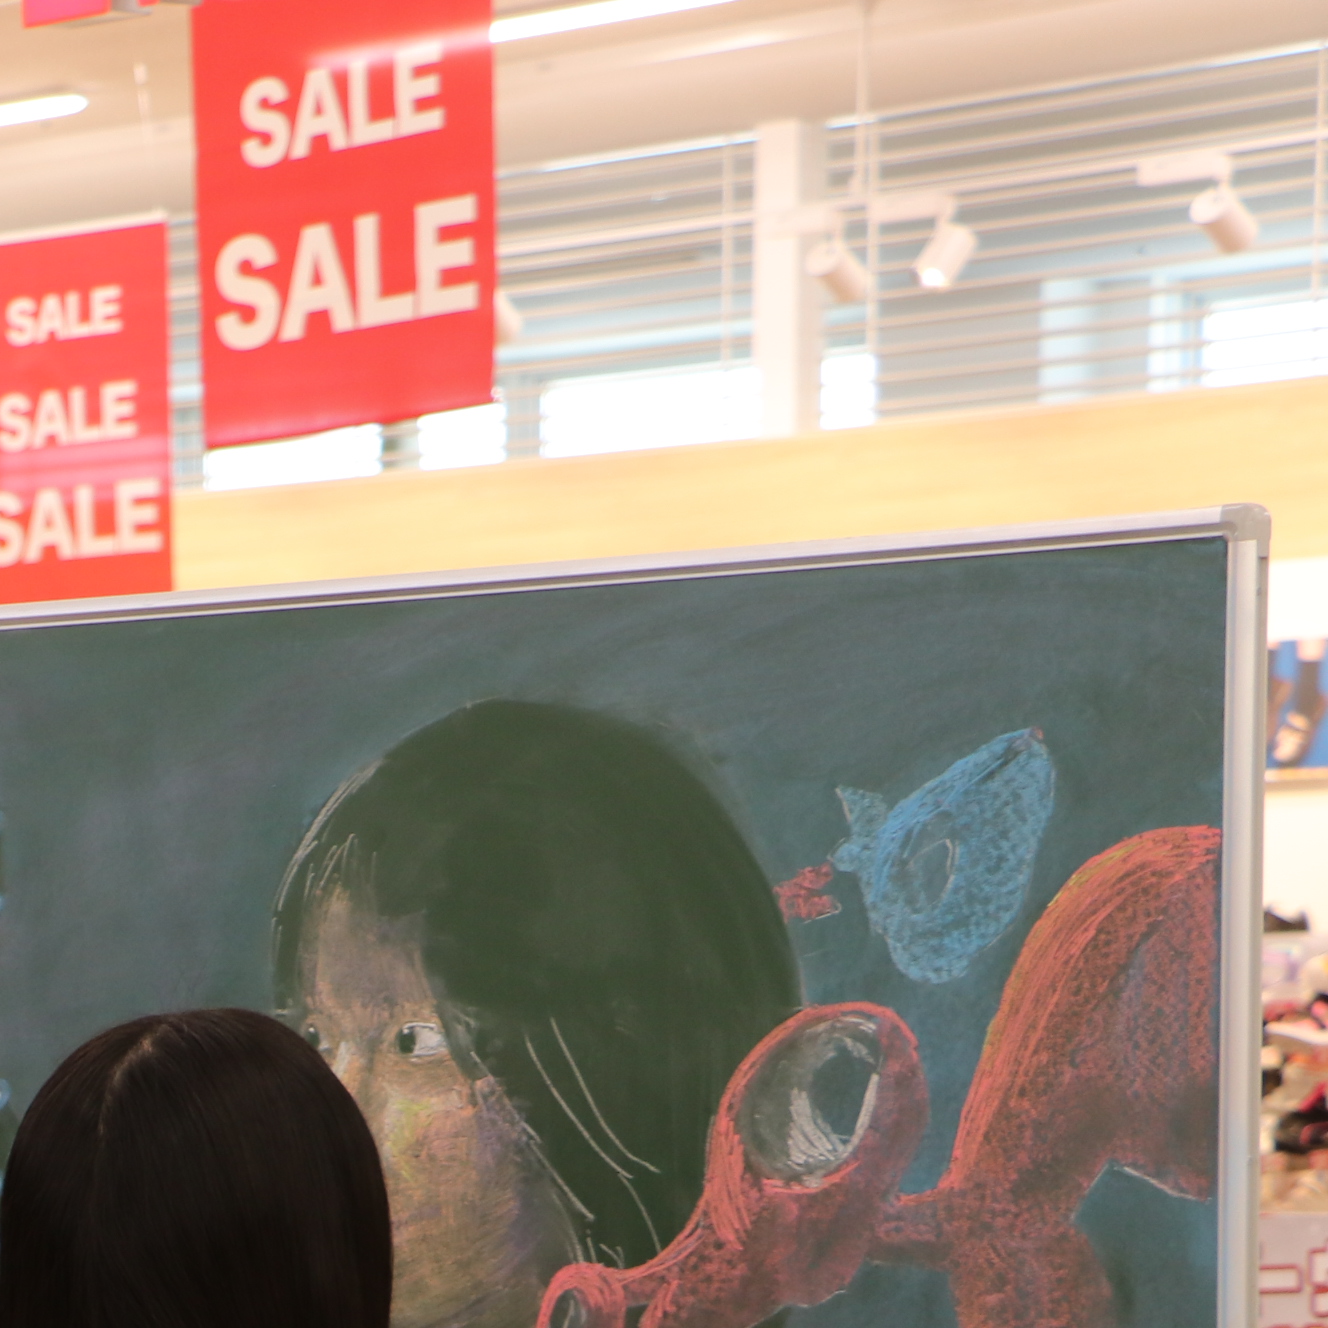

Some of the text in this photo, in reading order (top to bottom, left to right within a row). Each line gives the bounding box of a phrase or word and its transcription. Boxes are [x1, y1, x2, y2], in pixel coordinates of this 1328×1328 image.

[240, 43, 445, 168] SALE
[5, 284, 123, 347] SALE
[215, 194, 479, 351] SALE
